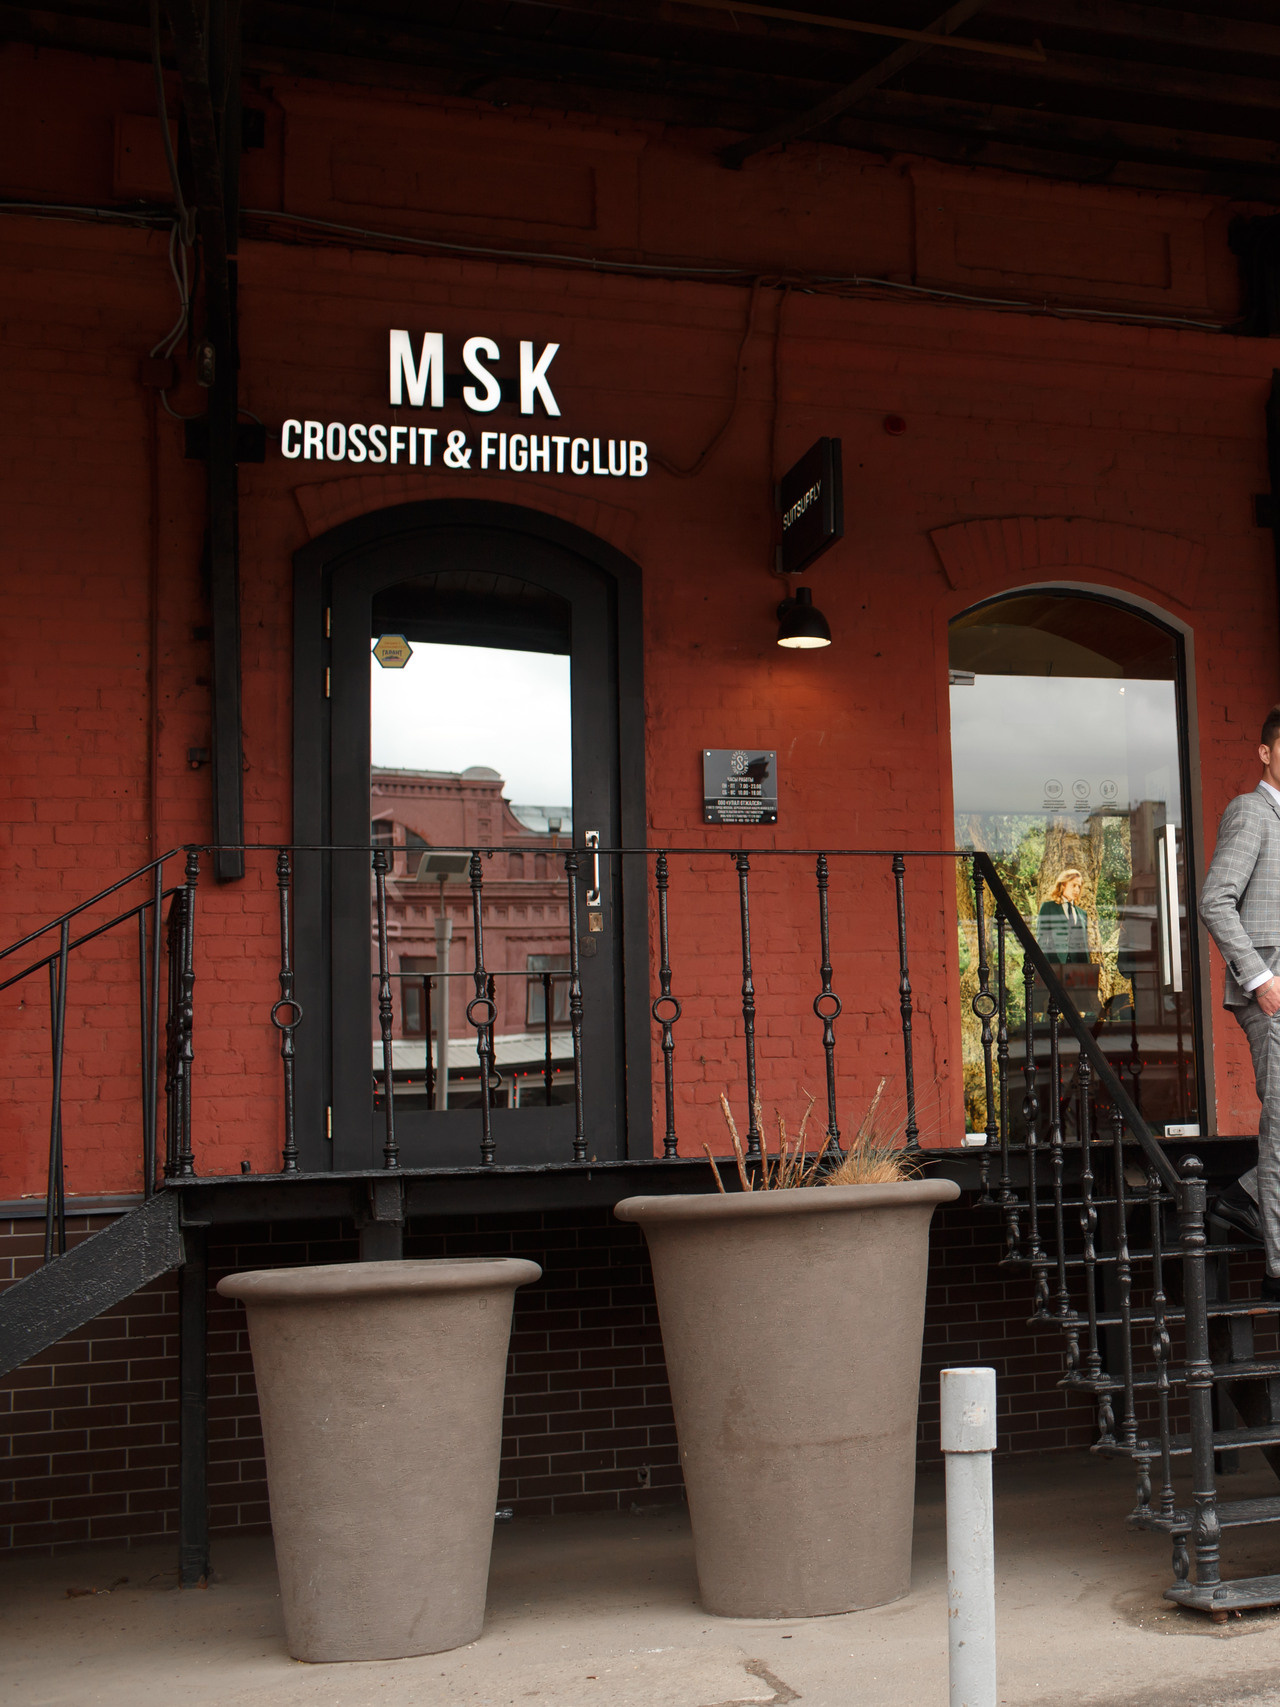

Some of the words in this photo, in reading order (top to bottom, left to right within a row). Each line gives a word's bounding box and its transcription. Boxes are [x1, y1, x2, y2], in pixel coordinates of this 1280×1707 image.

[281, 418, 438, 466] CROSSFIT
[442, 429, 473, 469] &
[480, 431, 649, 477] FIGHTCLUB
